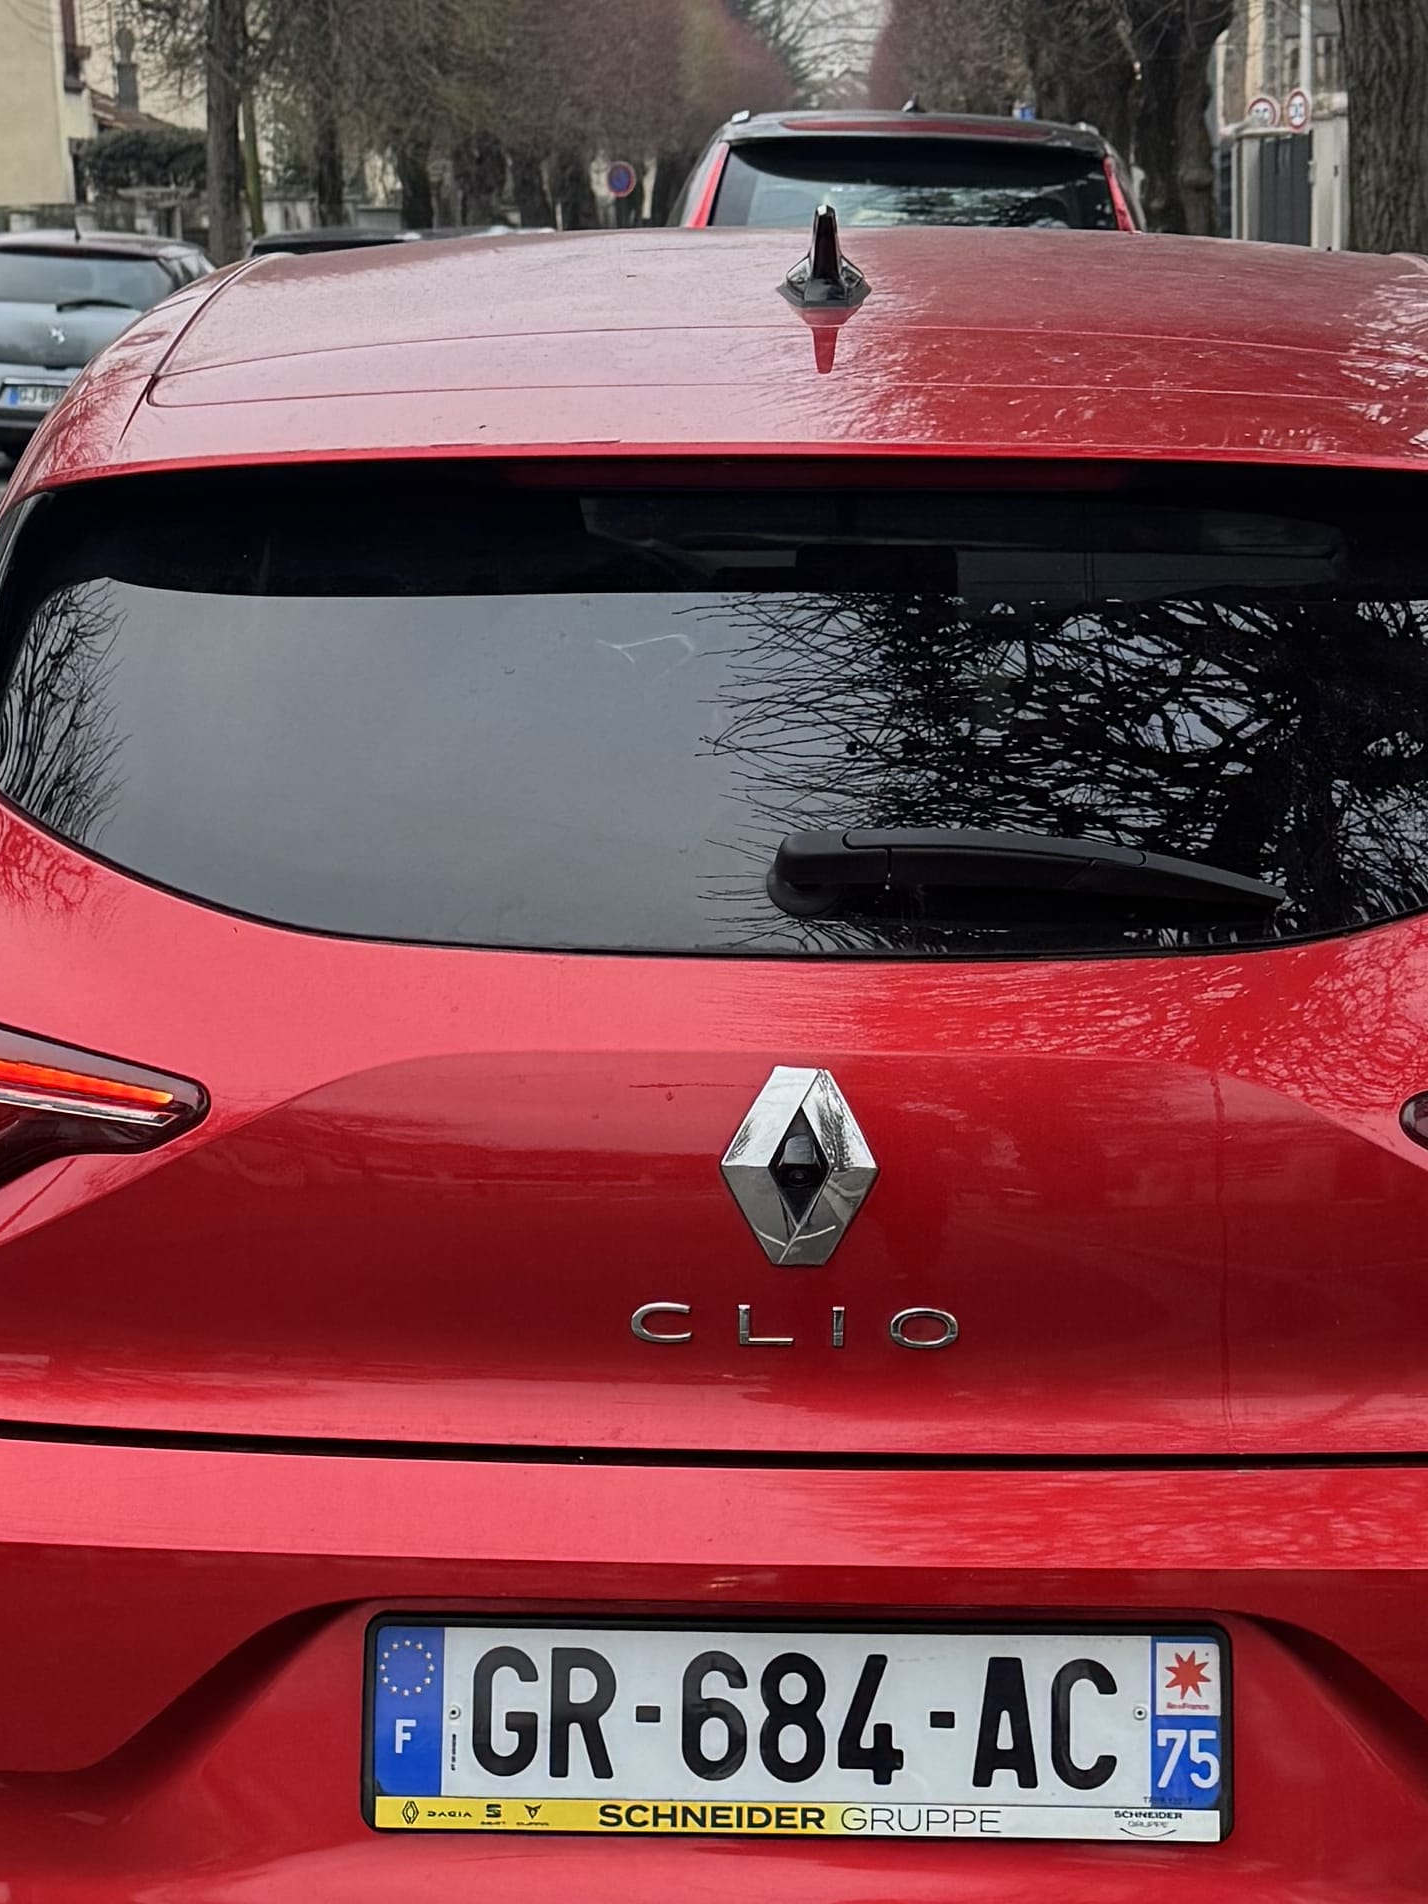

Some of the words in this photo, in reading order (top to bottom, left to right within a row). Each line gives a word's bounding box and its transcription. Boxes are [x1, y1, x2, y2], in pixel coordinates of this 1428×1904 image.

[630, 1301, 959, 1350] CLIO
[395, 1719, 417, 1754] F
[471, 1645, 1119, 1791] GR-684-AC
[1157, 1729, 1220, 1789] 75
[597, 1804, 826, 1831] SCHNEIDER
[839, 1806, 1003, 1833] GRUPPE
[1114, 1810, 1183, 1820] SCHNEIDER
